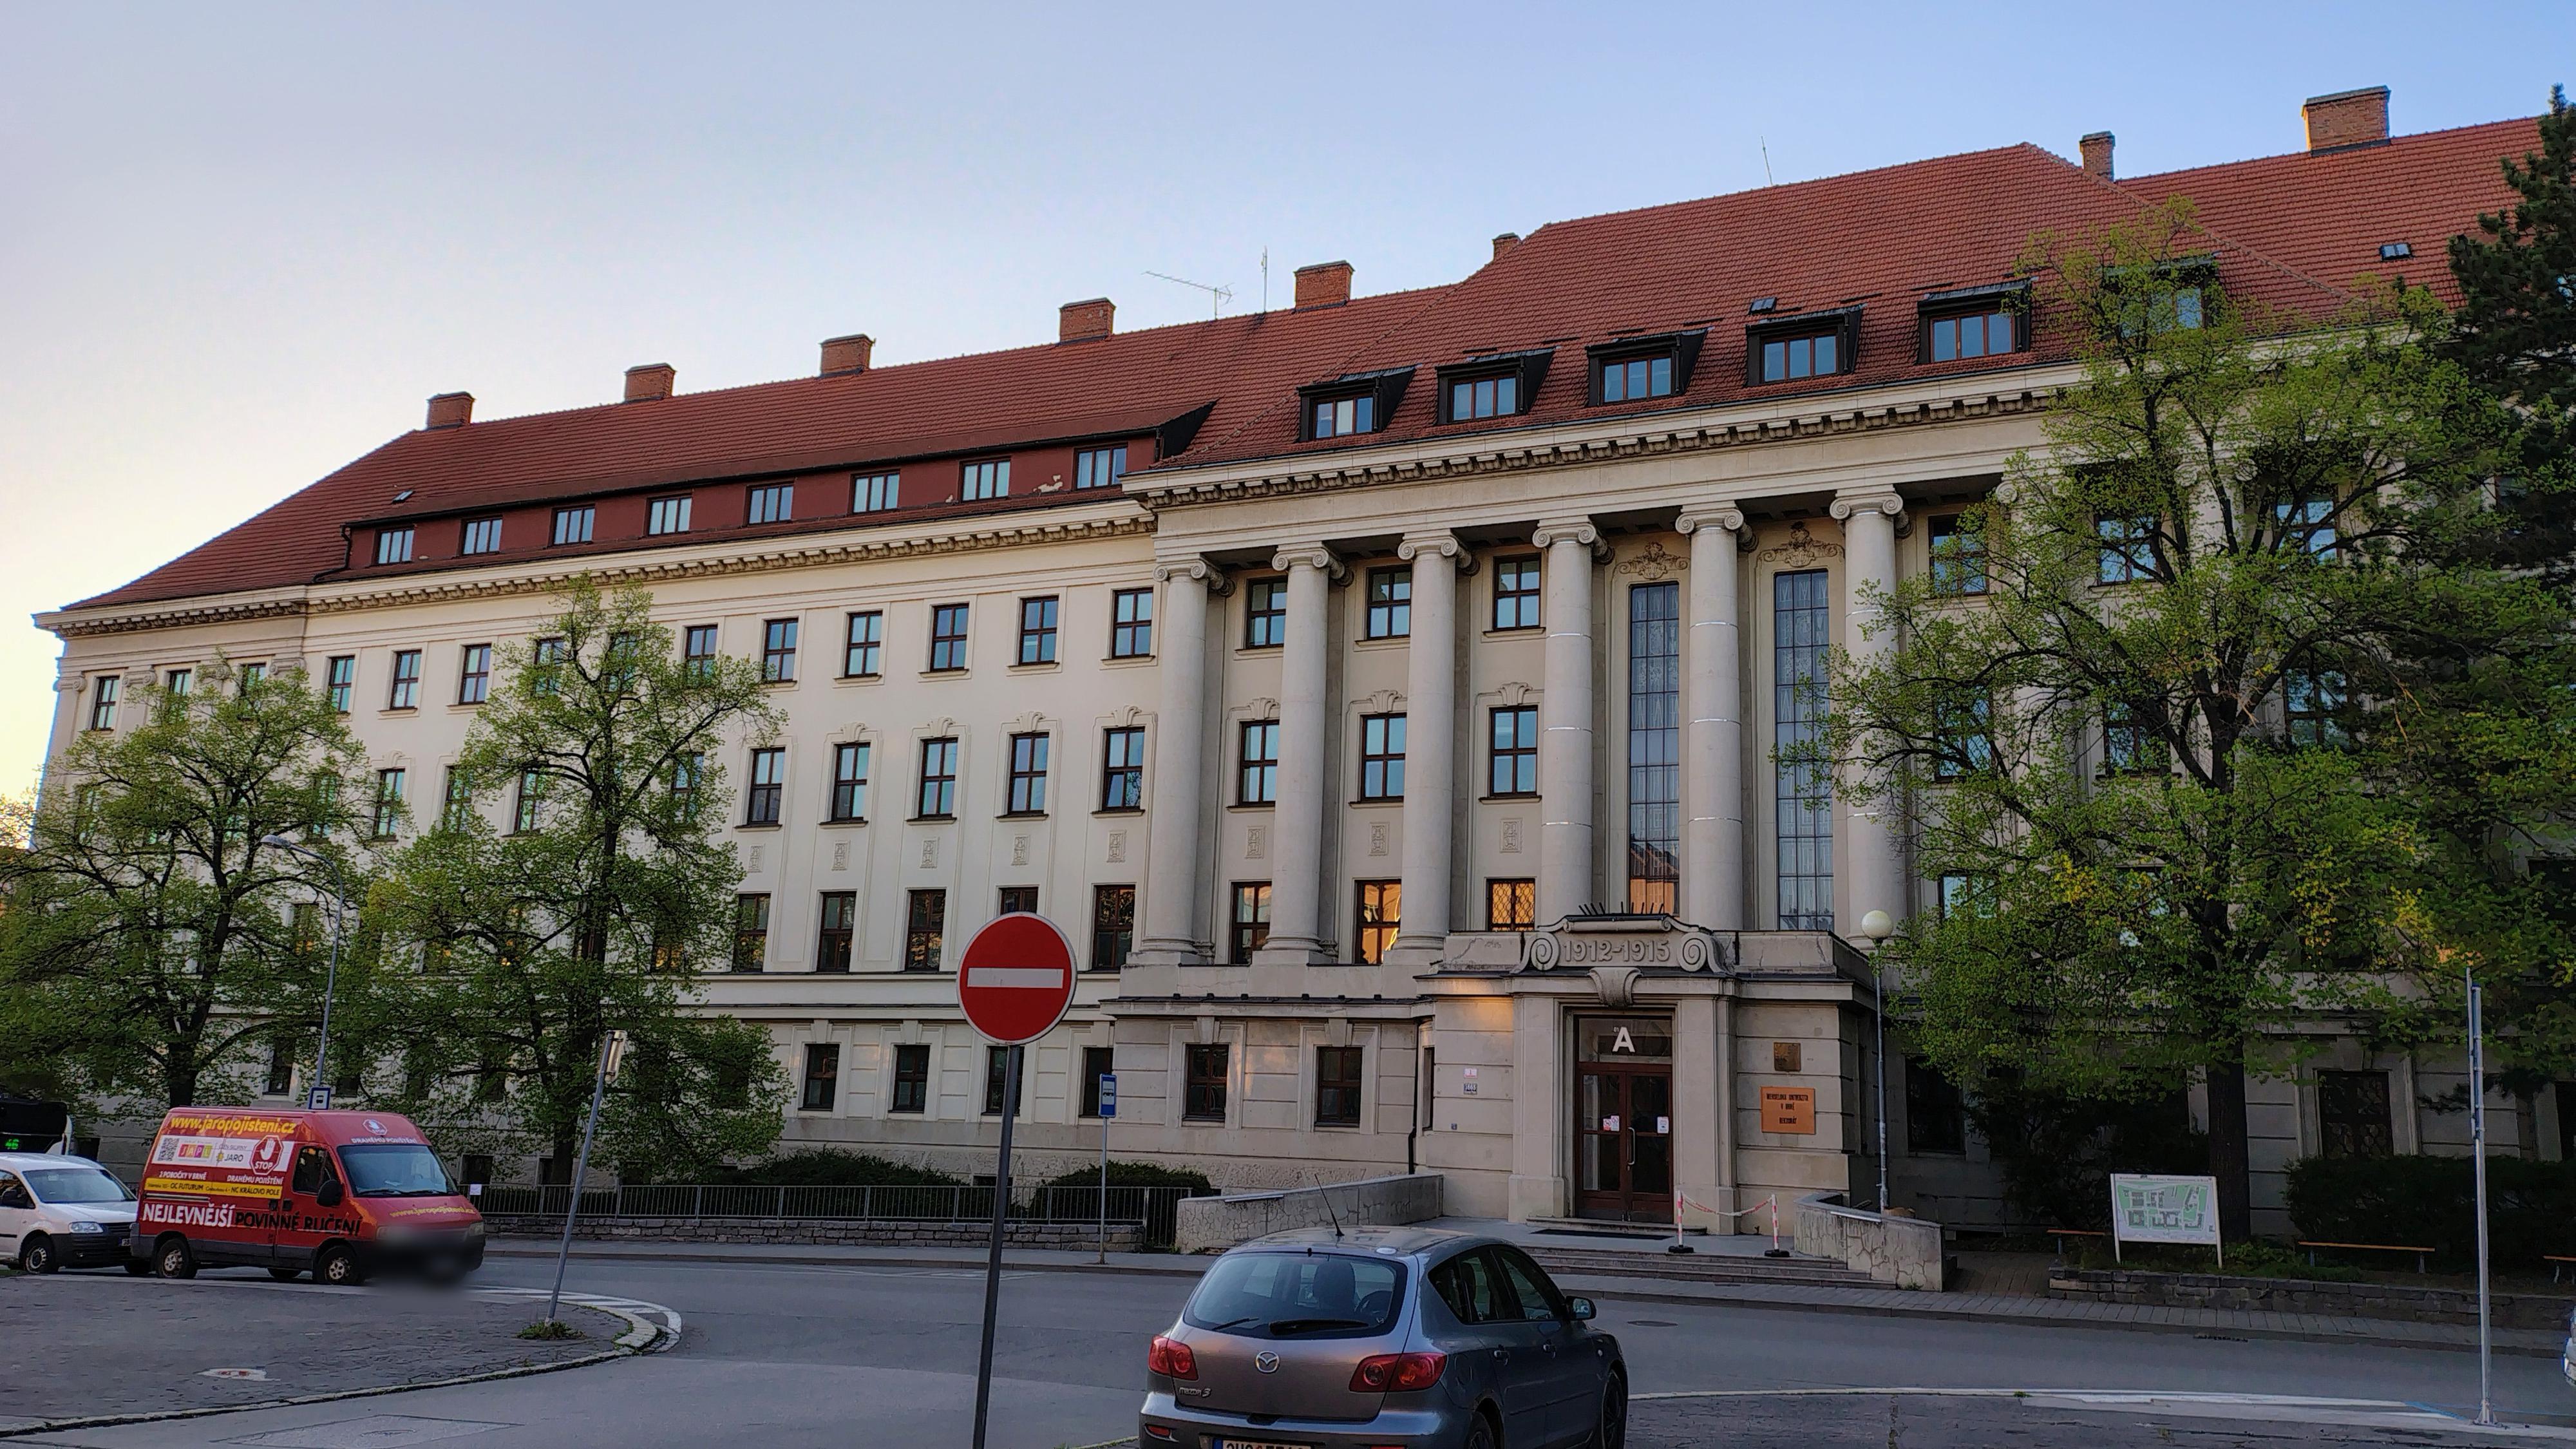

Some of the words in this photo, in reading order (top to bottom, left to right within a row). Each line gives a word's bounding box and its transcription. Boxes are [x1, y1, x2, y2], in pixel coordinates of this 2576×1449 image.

[1563, 940, 1671, 962] 1912-1915
[1612, 1027, 1636, 1052] A
[171, 1115, 296, 1135] www.jaropojisteni.cz
[254, 1161, 273, 1170] STOP
[227, 1175, 255, 1184] DRAHÉMU
[240, 1186, 265, 1195] KRÁLOVO
[142, 1203, 236, 1227] NEJLEVNĚJŠÍ
[235, 1211, 300, 1231] POVINNÉ
[303, 1214, 364, 1236] RUČENÍ
